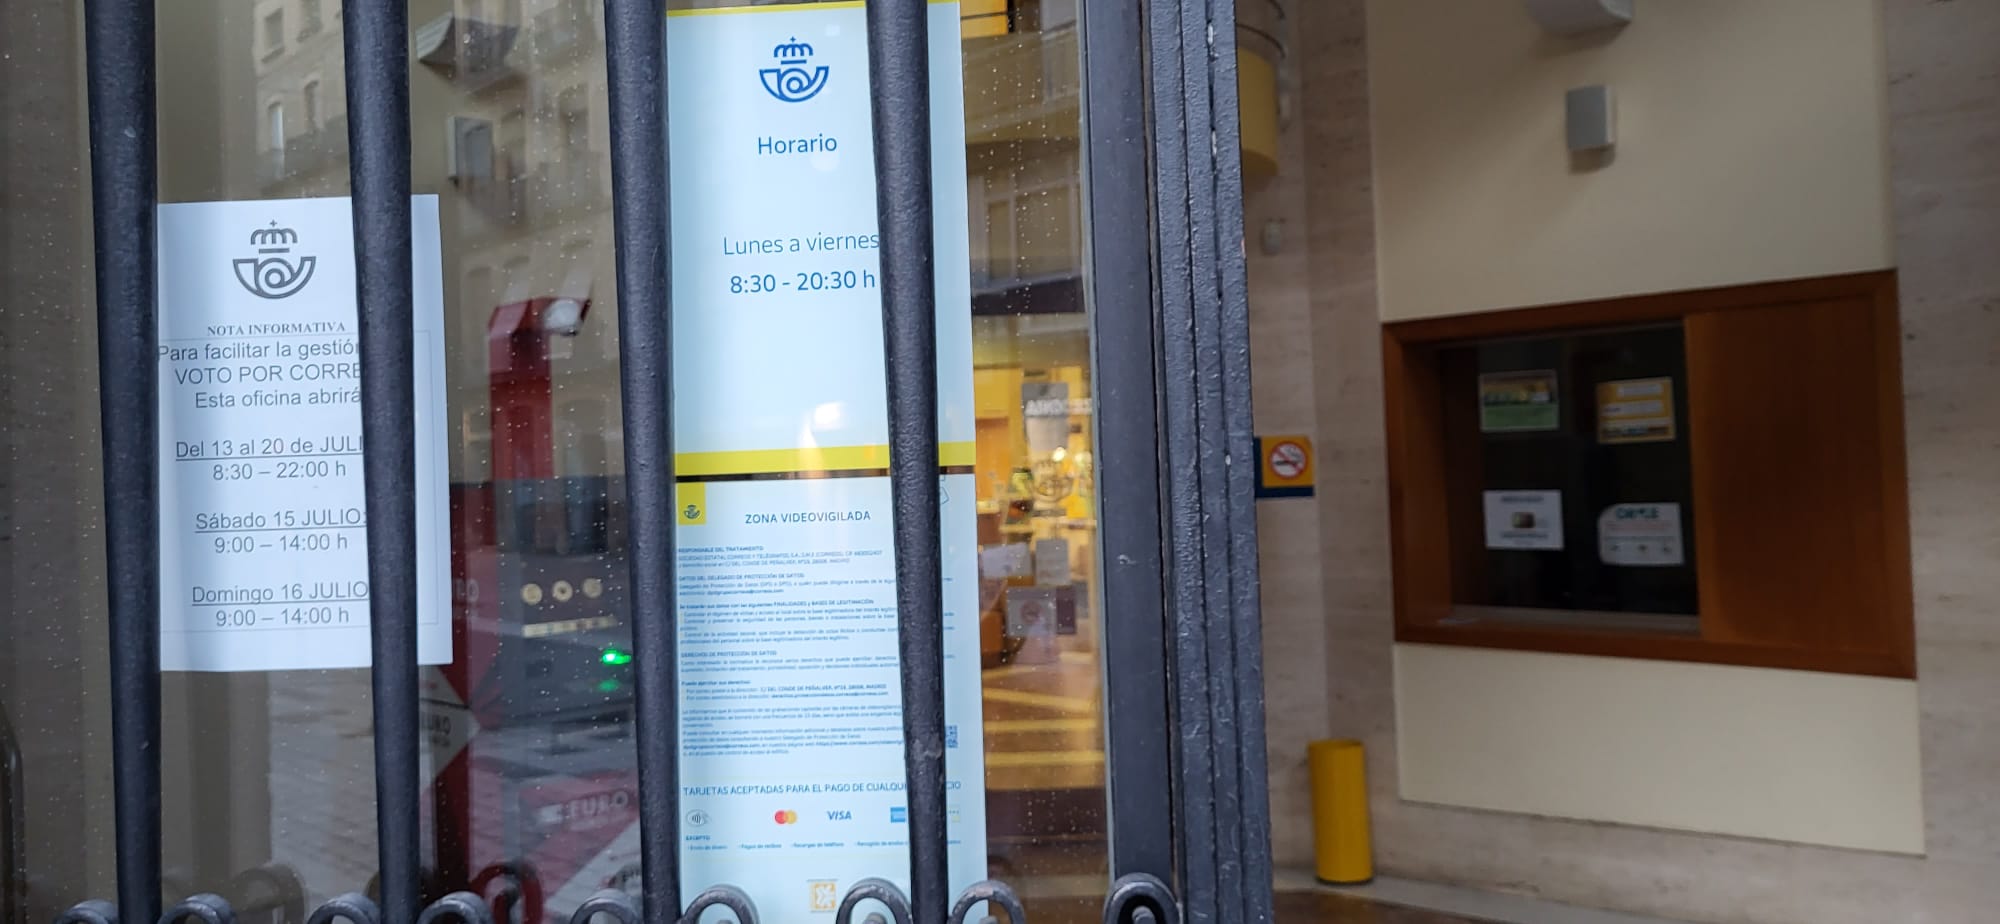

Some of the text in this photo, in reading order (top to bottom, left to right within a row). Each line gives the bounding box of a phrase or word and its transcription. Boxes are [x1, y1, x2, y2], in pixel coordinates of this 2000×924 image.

[757, 133, 838, 154] Horario
[723, 232, 880, 256] Lunes a viernes
[730, 274, 776, 294] 8:30
[797, 270, 857, 291] 20:30
[863, 269, 876, 288] h
[207, 322, 346, 337] NOTA INFORMATIVA
[158, 339, 359, 361] Para facilitar la gestió
[174, 362, 361, 385] VOTO POR CORRE
[196, 388, 362, 408] Esta oficina abrirá
[176, 435, 364, 458] Del 13 al 20 de JULI
[212, 463, 254, 481] 8:30
[276, 460, 328, 479] 22:00
[336, 460, 346, 477] h
[195, 512, 266, 530] Sábado
[273, 510, 296, 527] 15
[744, 510, 871, 525] ZONA VIDEOVIGILADA
[214, 536, 255, 554] 9:00
[279, 534, 330, 551] 14:00
[338, 532, 348, 550] h
[192, 585, 274, 604] Domingo
[281, 583, 303, 600] 16
[215, 609, 256, 627] 9:00
[281, 607, 332, 624] 14:00
[338, 606, 349, 623] h
[683, 782, 907, 797] TARJETAS ACEPTADAS PARA EL PAGO DE CUALQUI
[827, 810, 852, 821] VISA
